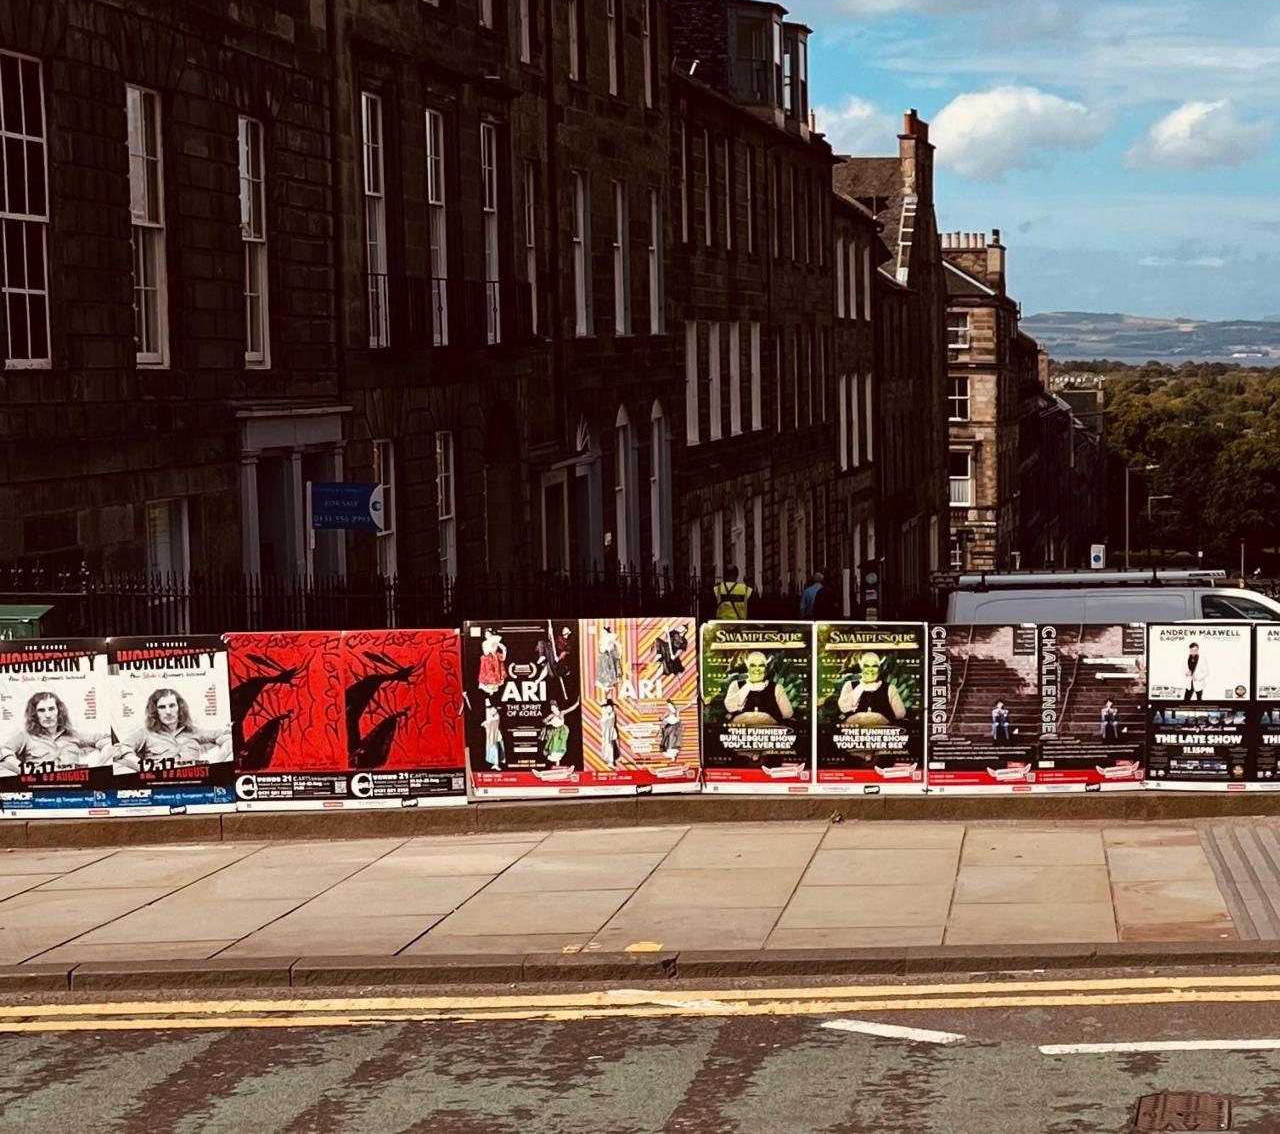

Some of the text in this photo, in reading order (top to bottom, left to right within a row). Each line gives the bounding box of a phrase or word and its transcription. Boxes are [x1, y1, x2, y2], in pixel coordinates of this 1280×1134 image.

[501, 681, 547, 702] ARI
[1155, 734, 1242, 744] THE LATE SHOW
